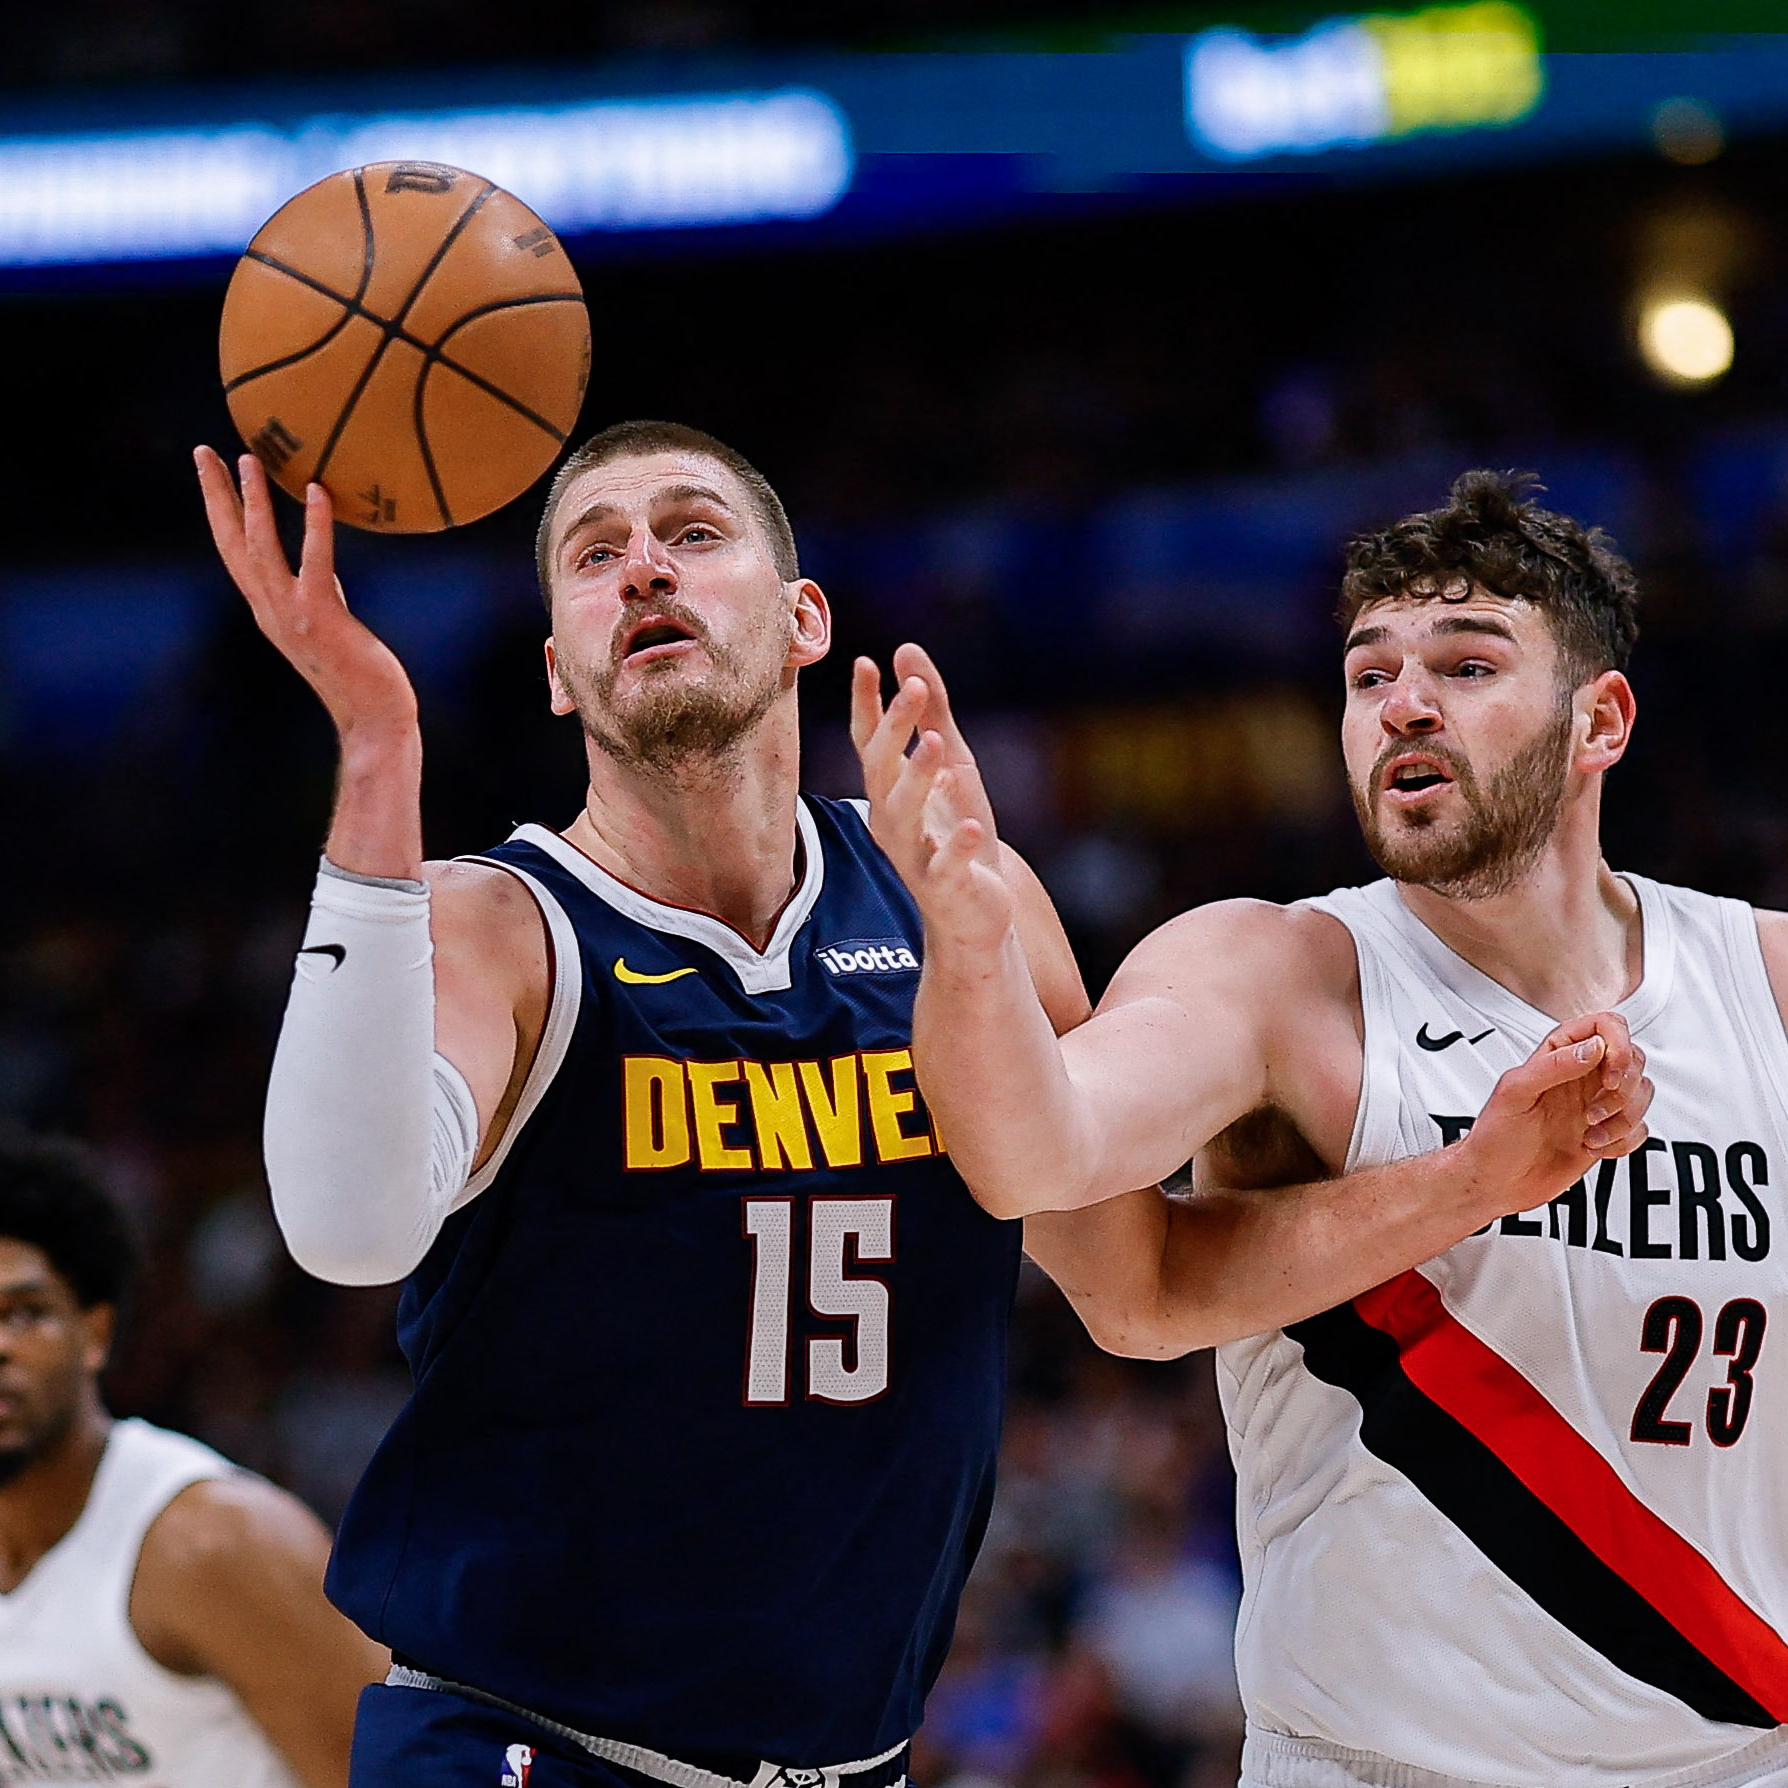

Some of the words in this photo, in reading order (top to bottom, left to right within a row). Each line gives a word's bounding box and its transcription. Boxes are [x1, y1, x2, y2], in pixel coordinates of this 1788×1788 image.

[816, 945, 919, 975] ibotta
[622, 1047, 949, 1172] DENVE
[741, 1195, 897, 1408] 15
[1630, 1295, 1768, 1448] 23
